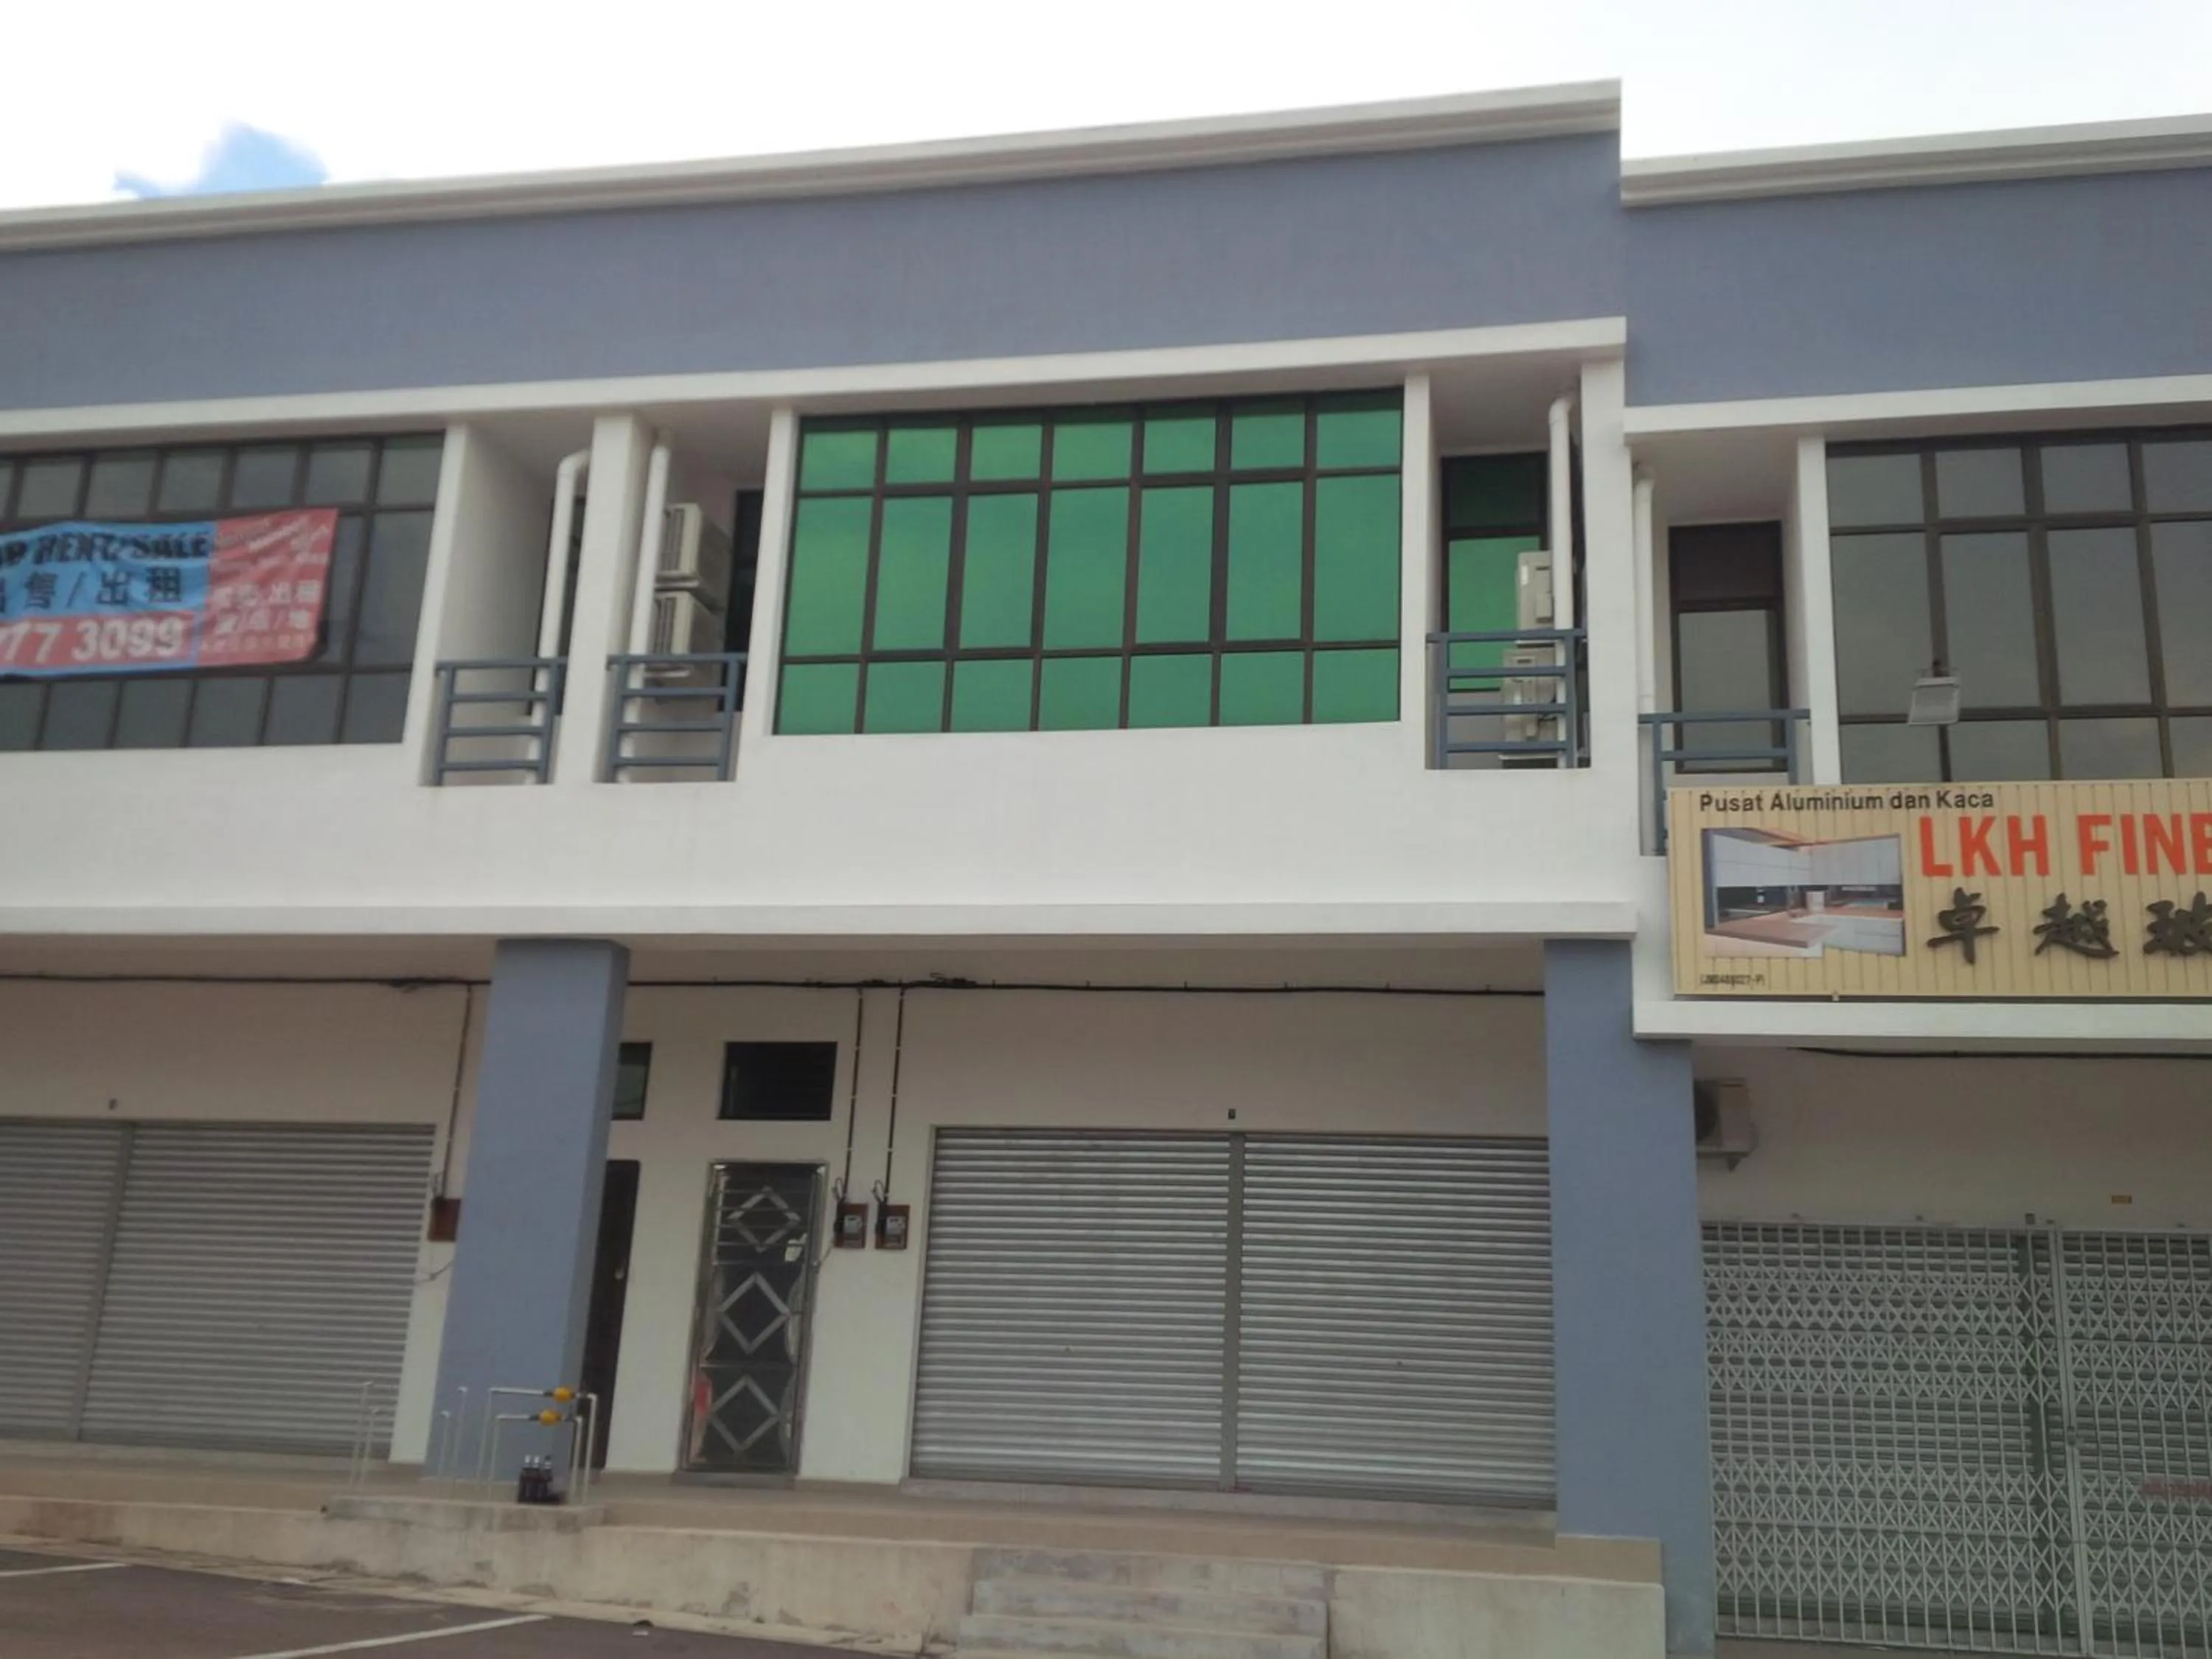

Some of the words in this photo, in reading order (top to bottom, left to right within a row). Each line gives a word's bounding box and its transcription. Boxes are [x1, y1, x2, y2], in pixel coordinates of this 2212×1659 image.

[0, 566, 182, 613] 售/出租
[71, 616, 186, 661] 3099
[1700, 793, 1763, 812] Pusat
[1770, 791, 1883, 811] Aluminium
[1890, 791, 1930, 809] dan
[1936, 790, 1994, 809] Kaca
[1919, 815, 2050, 877] LKH
